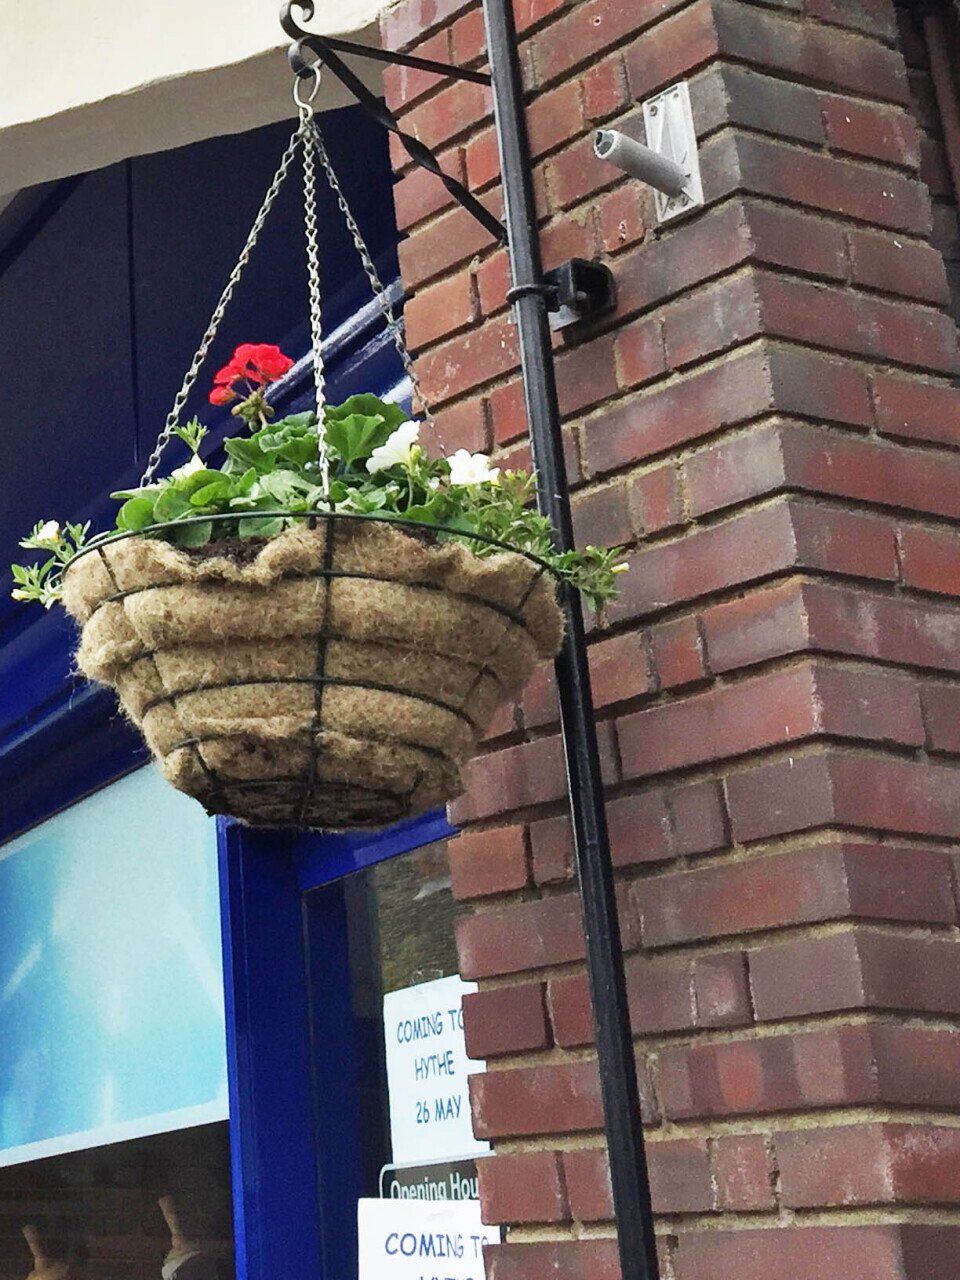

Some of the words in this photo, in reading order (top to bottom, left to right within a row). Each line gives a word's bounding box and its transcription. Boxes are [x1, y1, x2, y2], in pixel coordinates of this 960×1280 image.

[397, 1011, 443, 1044] COMING
[415, 1050, 455, 1081] HYTHE
[416, 1100, 430, 1124] 26
[435, 1095, 461, 1121] MAY
[385, 1232, 464, 1259] COMING
